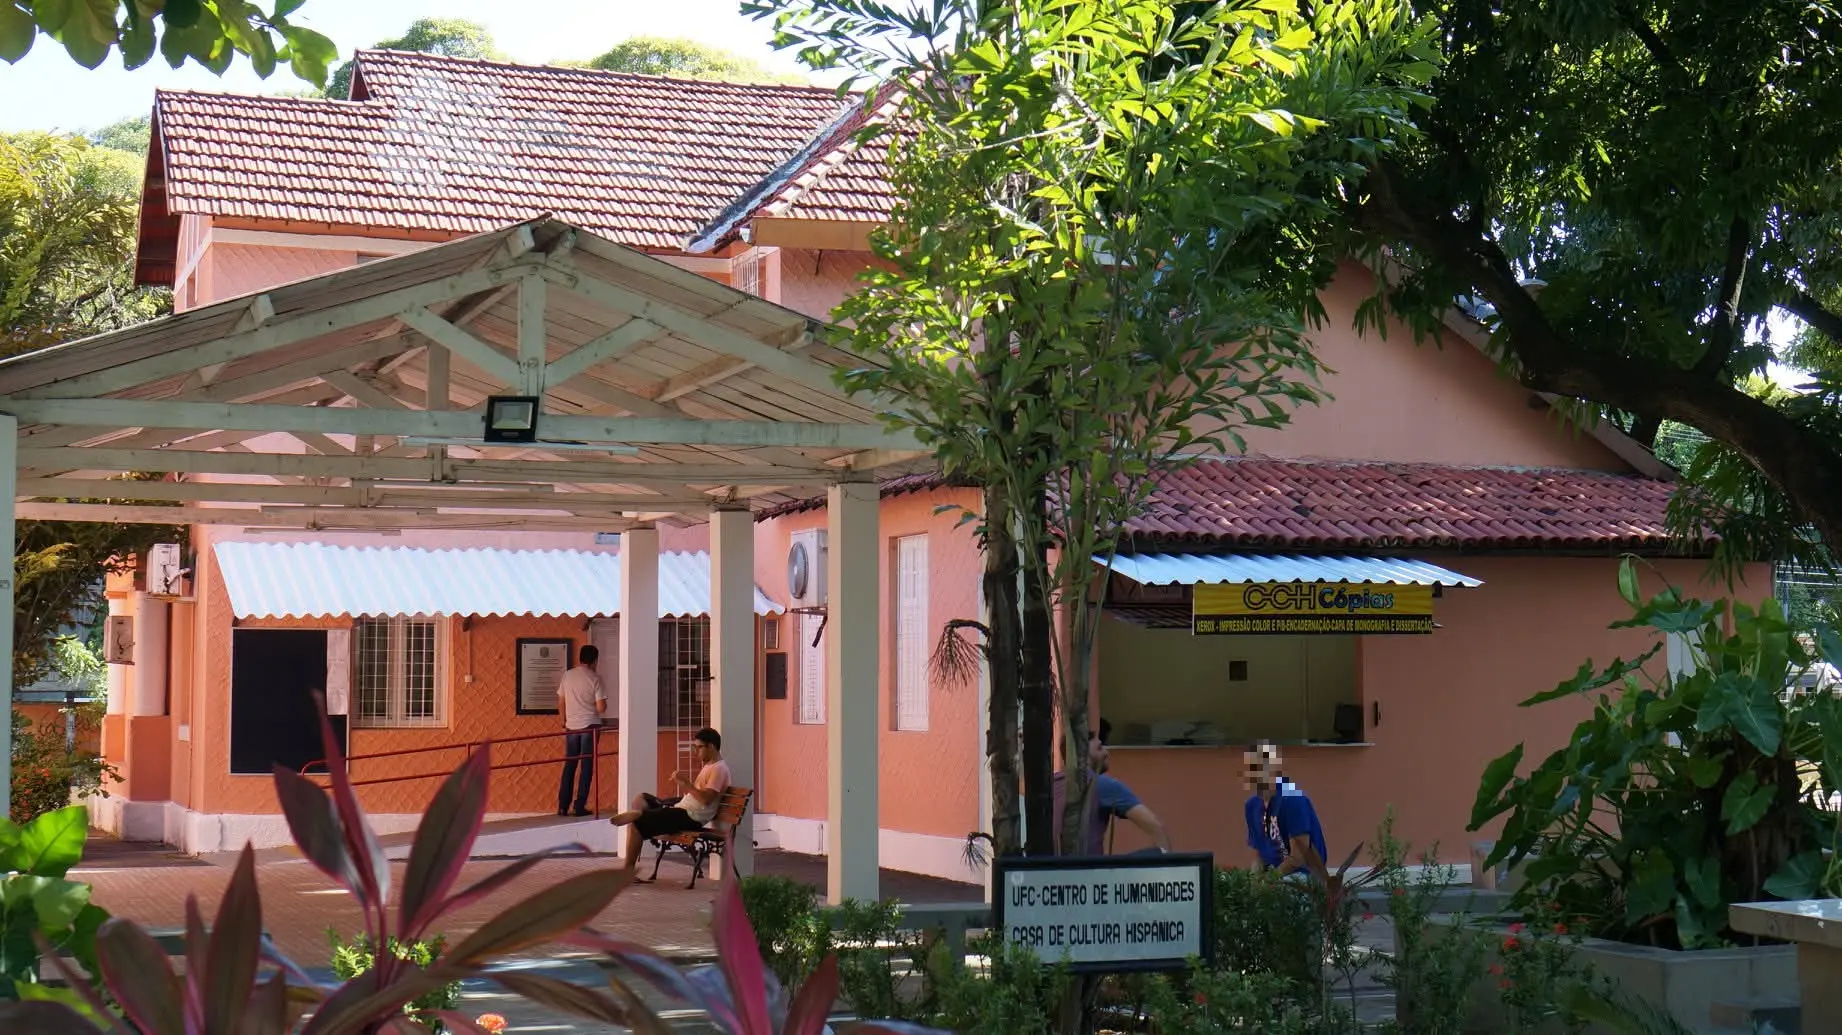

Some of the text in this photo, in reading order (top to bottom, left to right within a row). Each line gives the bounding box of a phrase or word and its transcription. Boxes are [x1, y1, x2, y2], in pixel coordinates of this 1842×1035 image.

[1243, 584, 1394, 612] CCH Cópias
[1196, 620, 1215, 632] XEROX
[1219, 617, 1251, 632] IMPRESSÃO
[1252, 619, 1270, 631] COLOR
[1346, 620, 1354, 631] DE
[1355, 619, 1390, 631] MONOGRAFIA
[1391, 620, 1396, 631] E
[1012, 881, 1195, 907] UFC-CENTRO DE HUMANIDADES
[1012, 925, 1044, 948] CASA
[1049, 925, 1065, 945] DE
[1069, 922, 1121, 945] CULTURA
